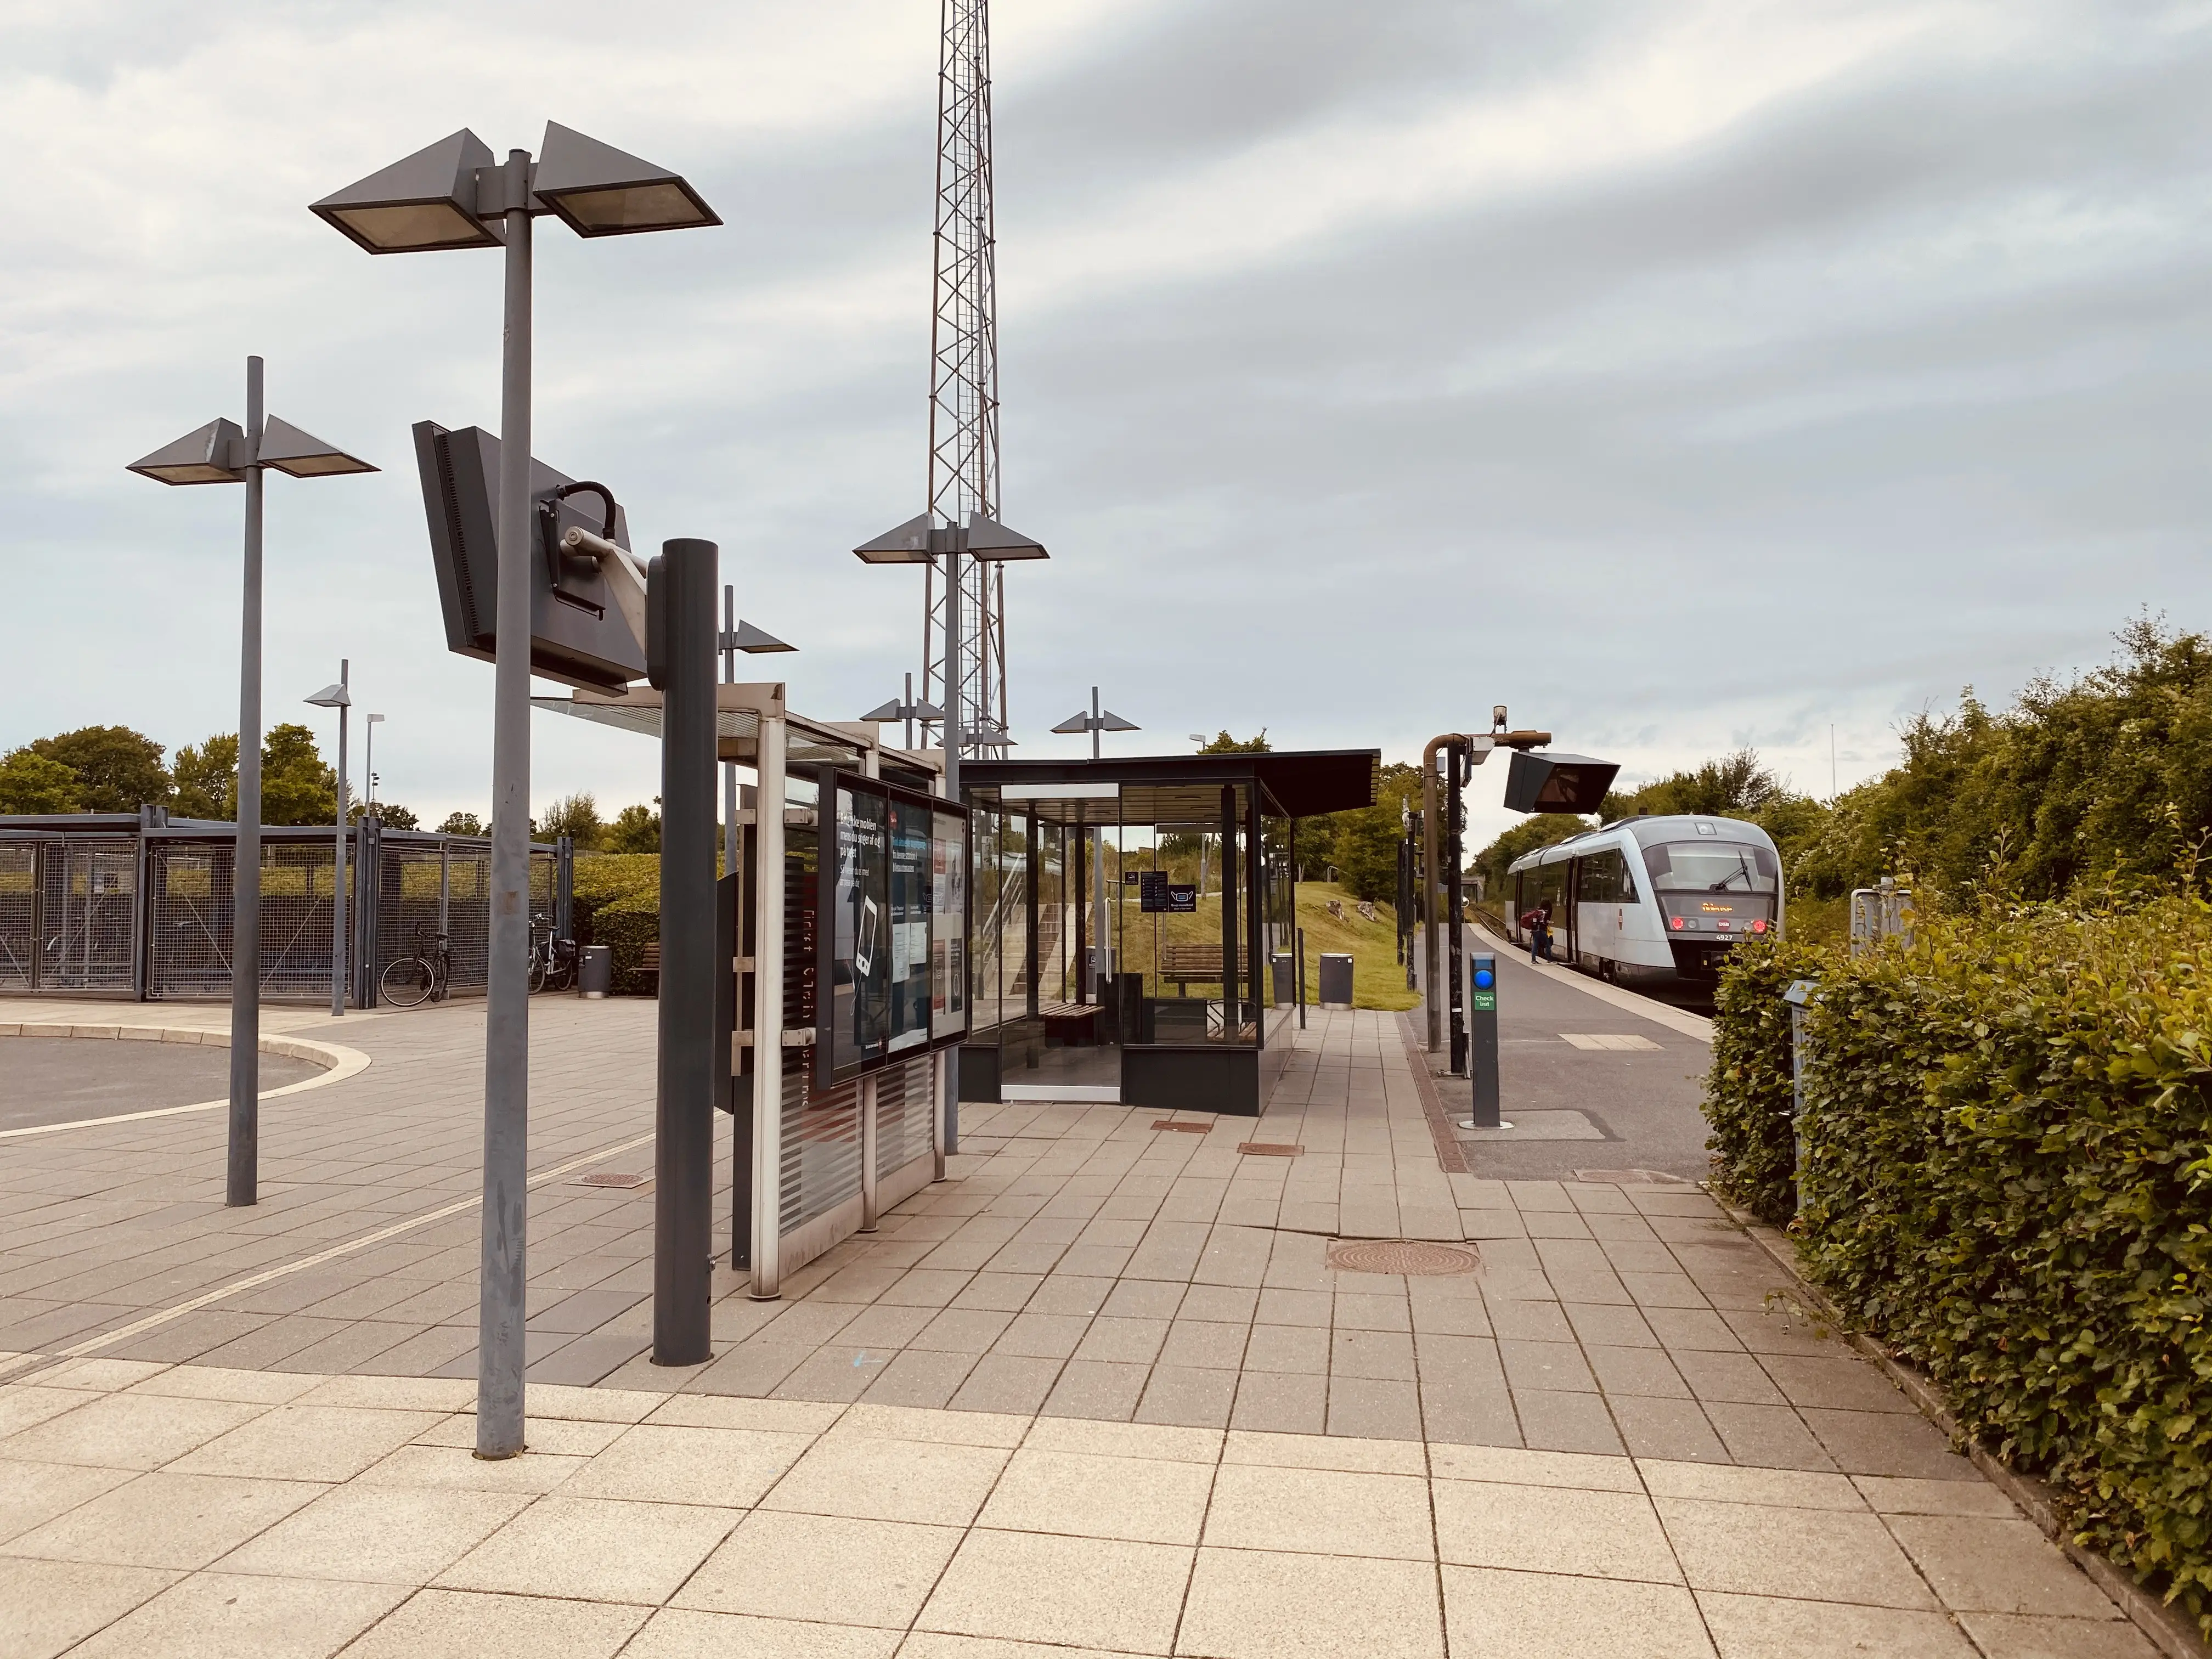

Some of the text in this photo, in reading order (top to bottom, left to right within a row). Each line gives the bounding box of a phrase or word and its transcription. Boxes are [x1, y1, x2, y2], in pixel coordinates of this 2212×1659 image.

[851, 831, 857, 842] du
[870, 834, 874, 845] af
[874, 836, 880, 848] og
